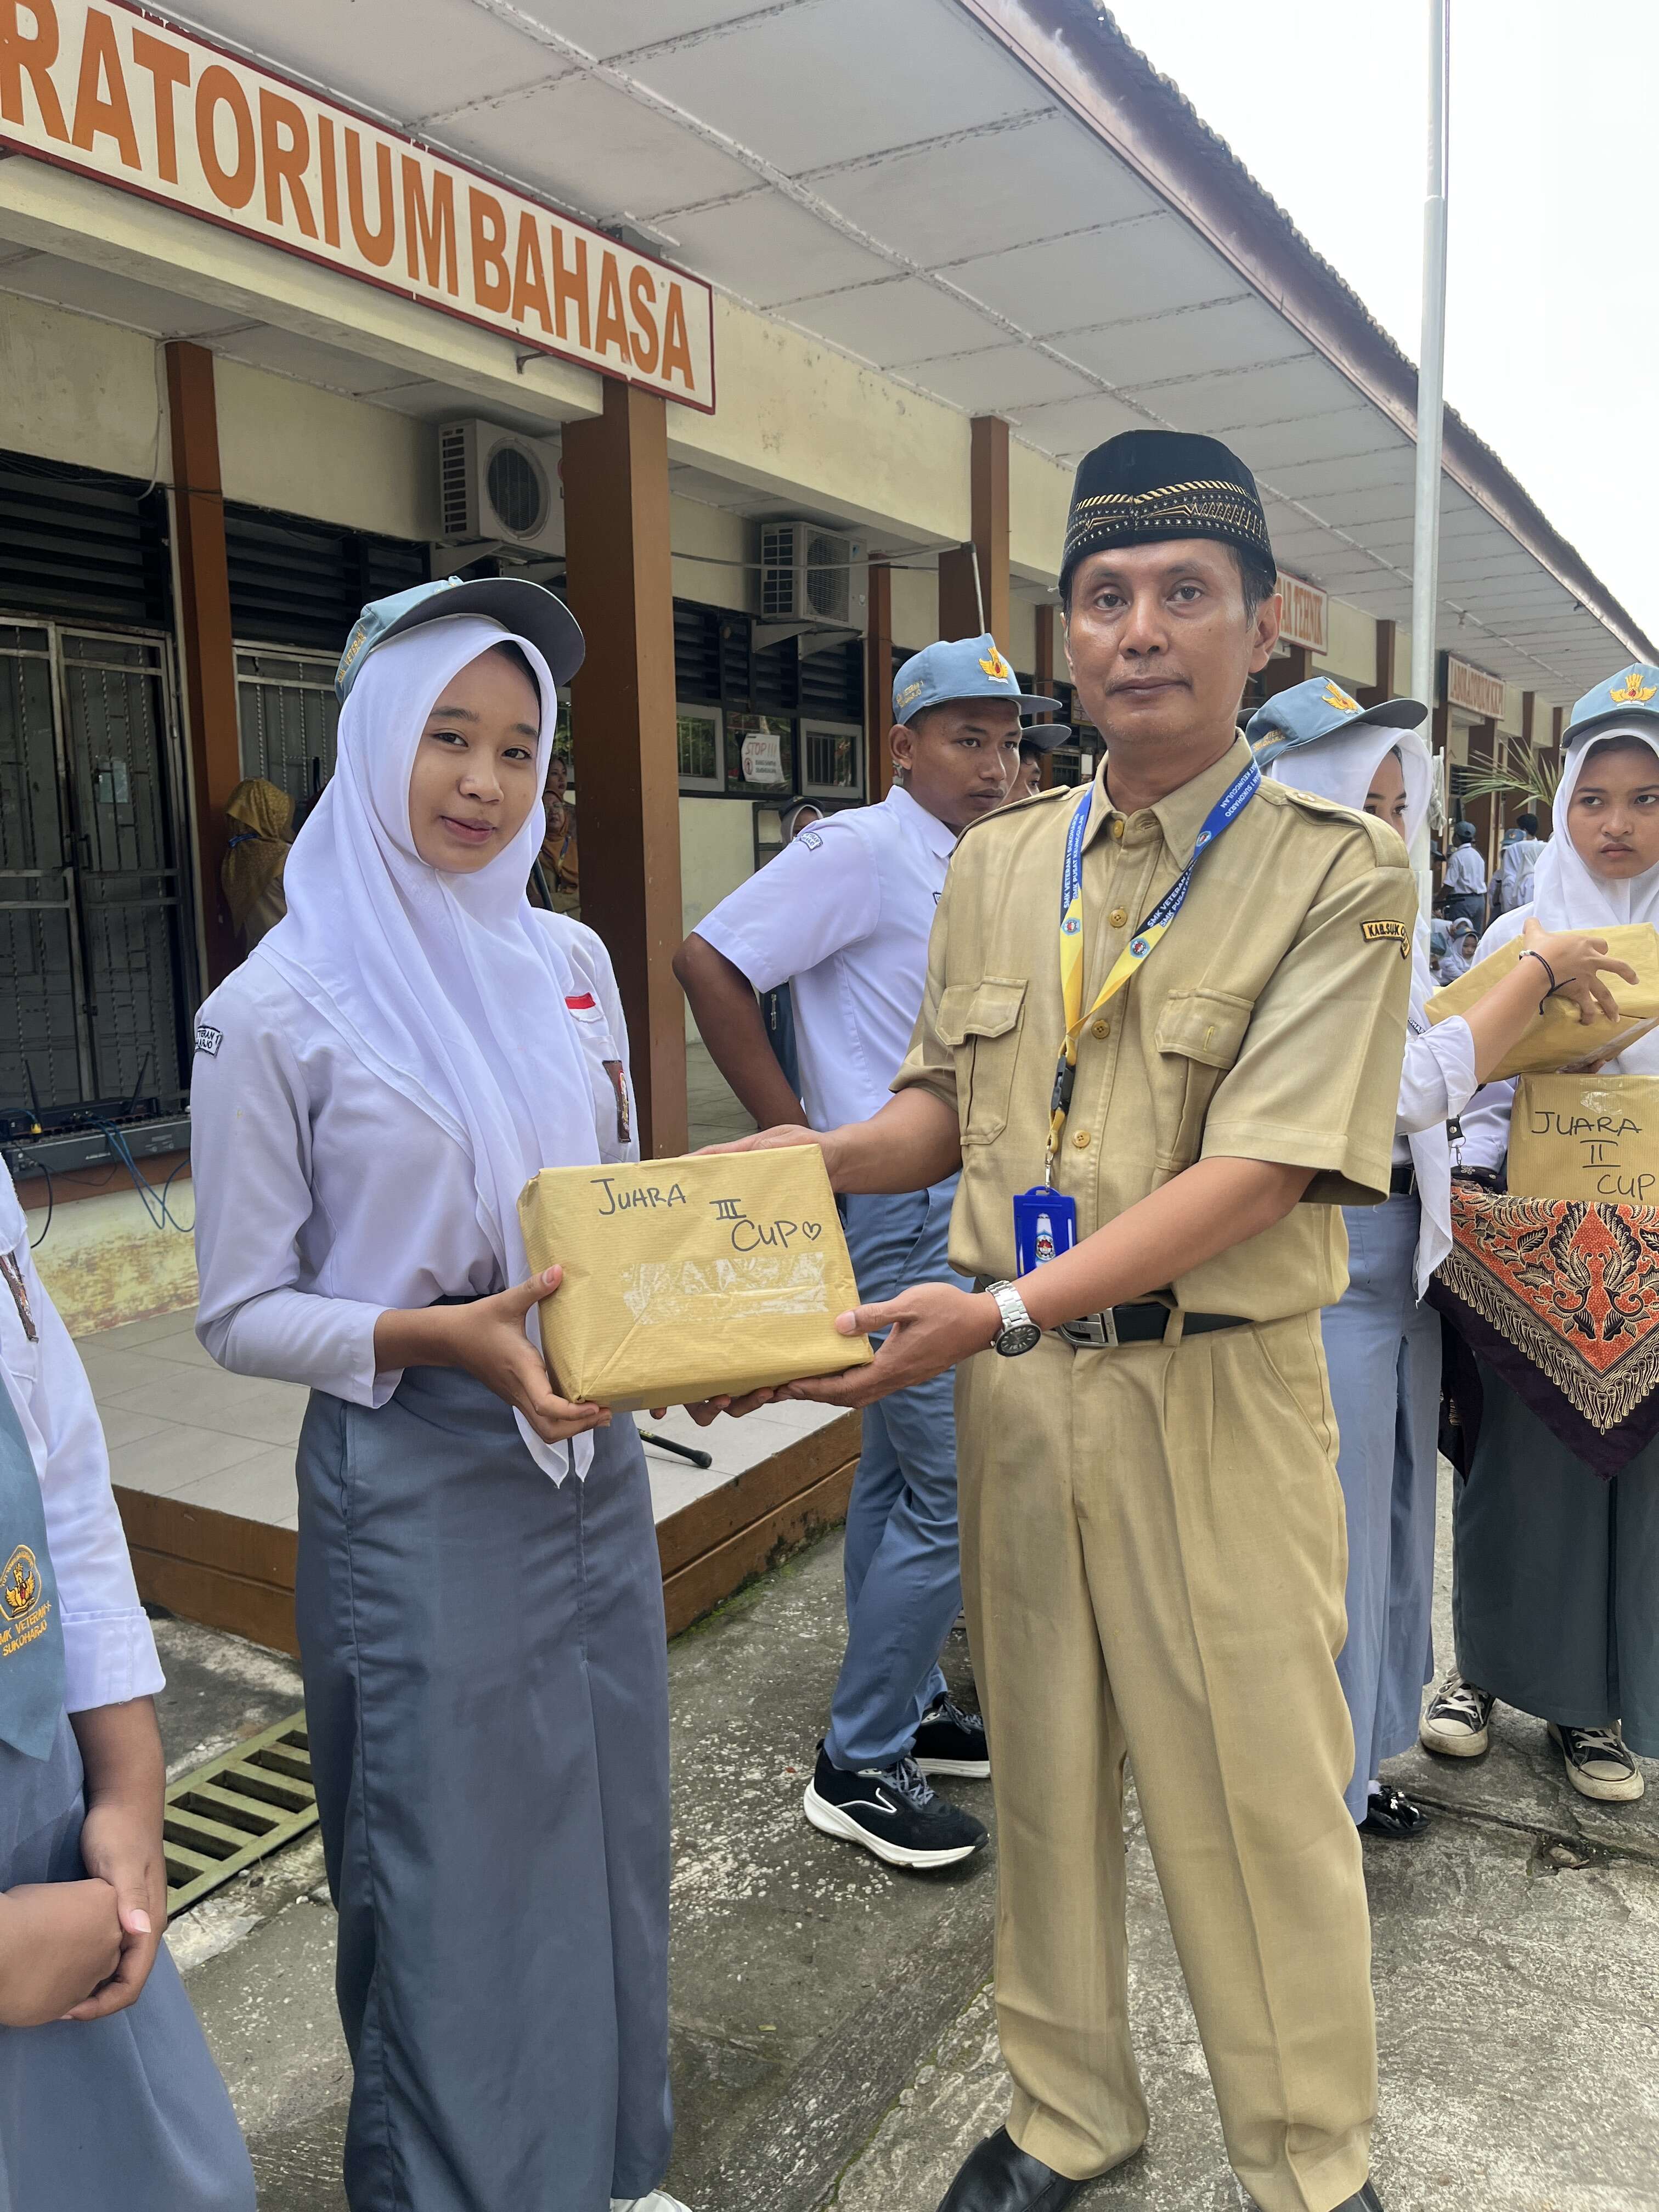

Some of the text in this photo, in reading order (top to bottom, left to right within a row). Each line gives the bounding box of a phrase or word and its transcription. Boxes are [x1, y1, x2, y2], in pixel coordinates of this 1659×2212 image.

[0, 0, 695, 391] RATORIUM BAHASA
[745, 742, 766, 755] STOP
[1225, 785, 1252, 817] SUKOHARJO
[1147, 910, 1163, 927] SMK
[1160, 876, 1186, 910] VETERAN
[1160, 885, 1186, 927] SMK PUSAT
[1532, 1111, 1642, 1136] JUARA
[1580, 1139, 1621, 1168] II
[590, 1178, 747, 1220] JUARA III
[1597, 1173, 1656, 1201] CUP
[731, 1220, 798, 1252] CUP
[15, 1604, 47, 1634] VETERAN
[3, 1619, 47, 1656] SUKOHARJO
